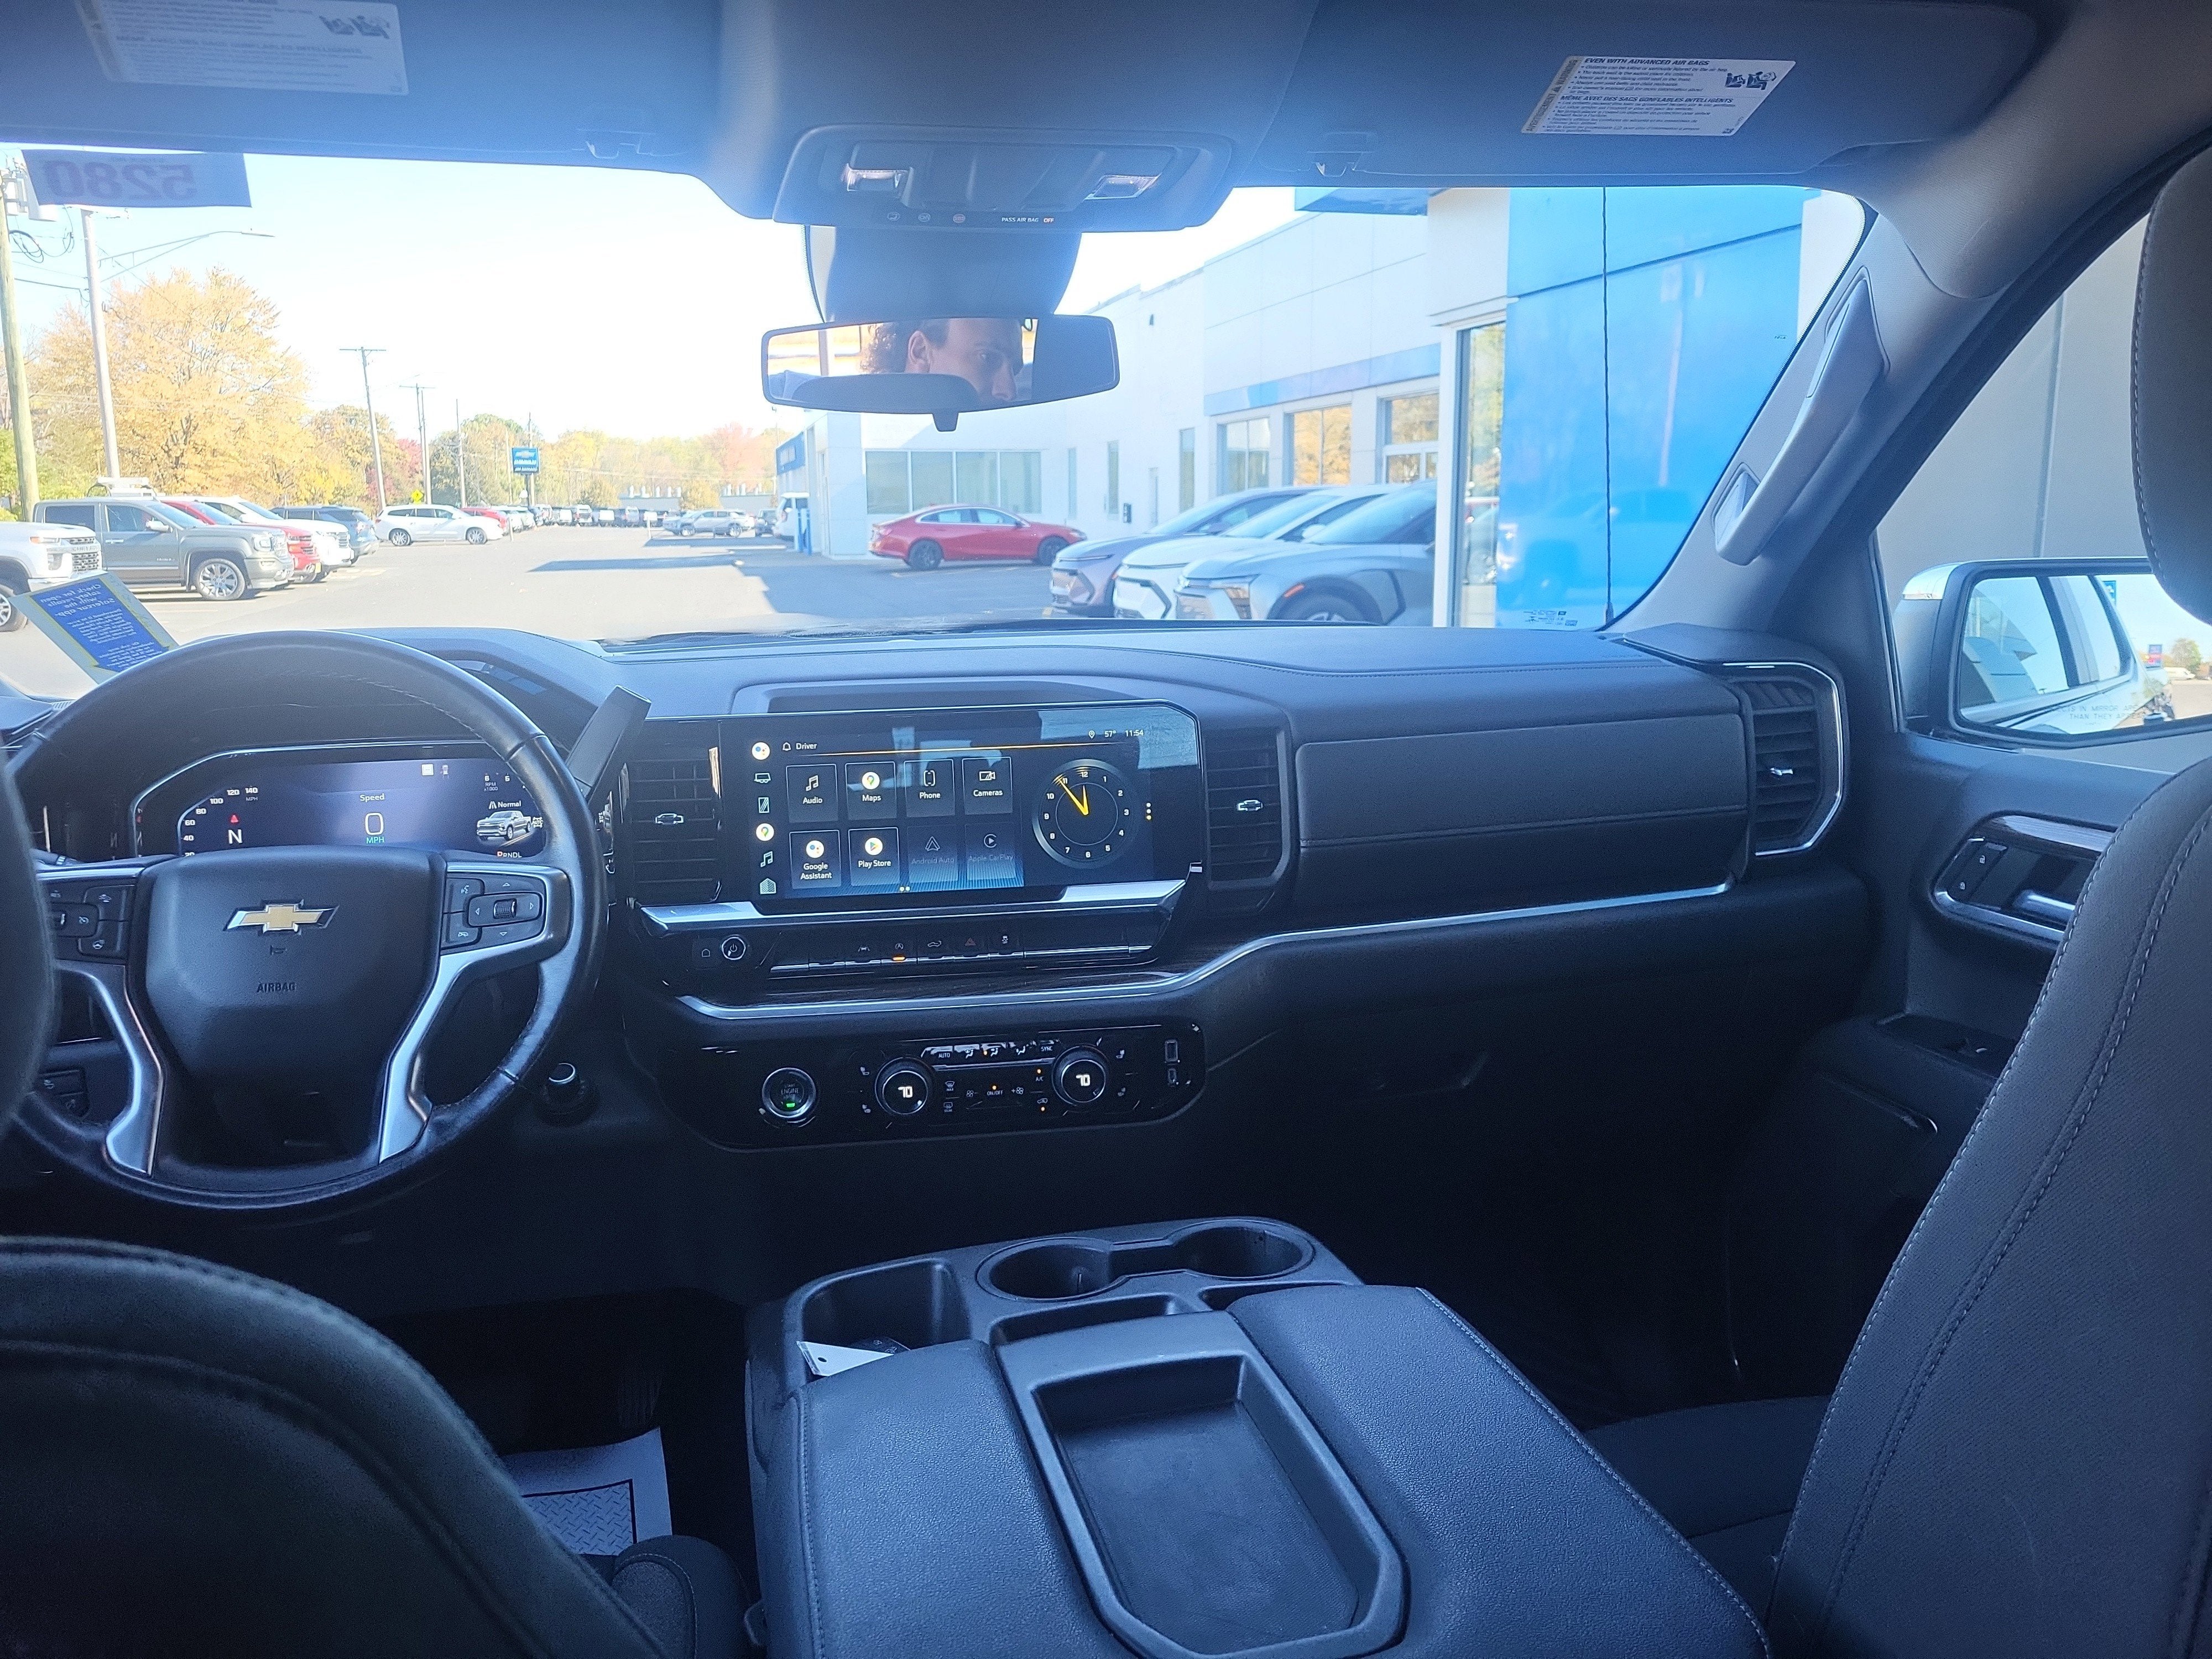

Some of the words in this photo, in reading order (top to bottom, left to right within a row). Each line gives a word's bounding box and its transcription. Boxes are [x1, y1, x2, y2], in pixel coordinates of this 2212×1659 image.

[359, 792, 385, 803] Speed
[862, 795, 881, 803] Maps
[498, 800, 521, 808] Normal
[365, 812, 384, 836] 0
[228, 829, 242, 844] N
[804, 862, 828, 872] Google
[858, 860, 872, 869] Play
[257, 982, 297, 993] AIRBAG
[1076, 1073, 1091, 1086] 70
[898, 1086, 912, 1098] 70
